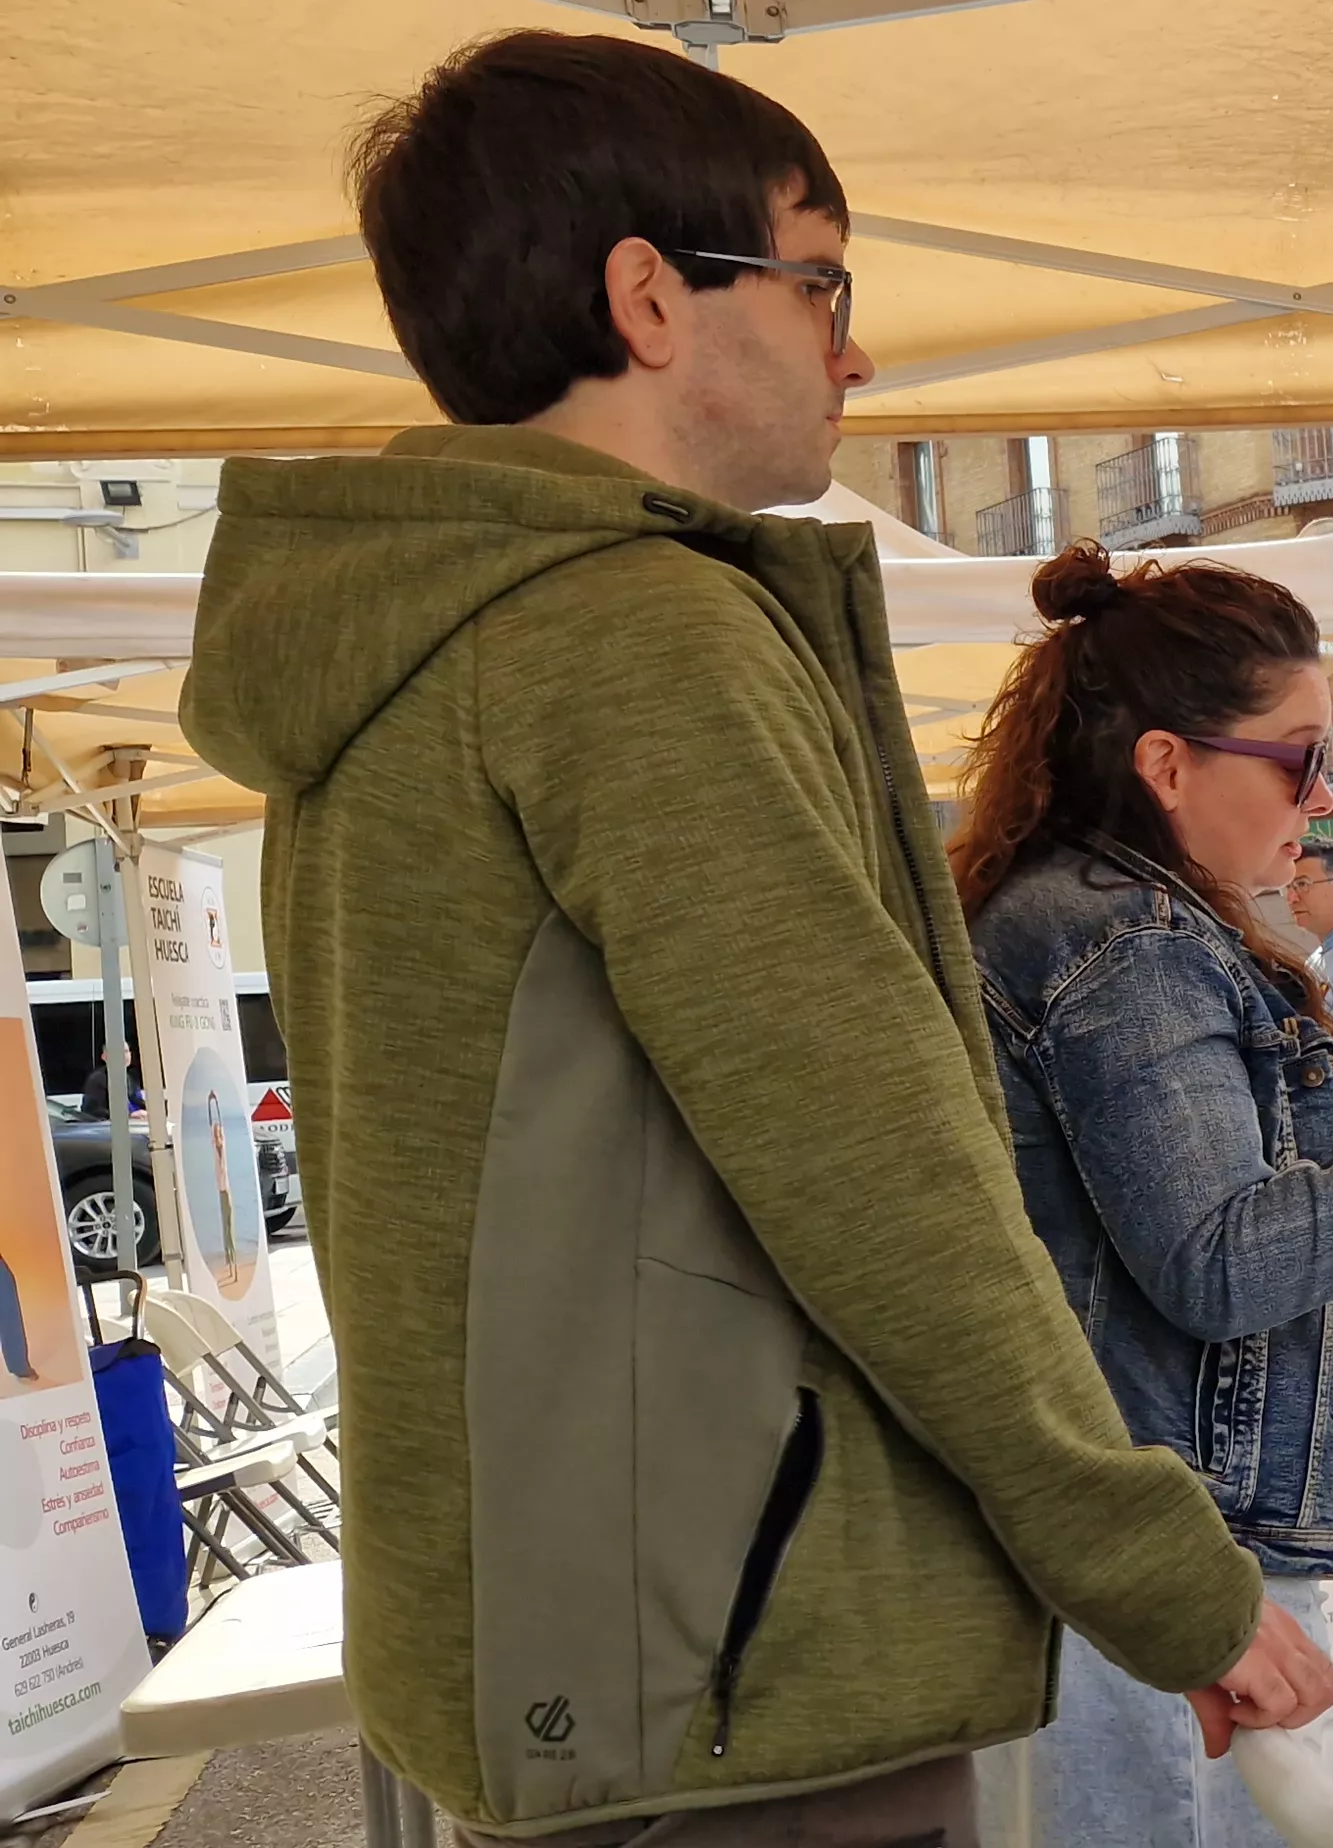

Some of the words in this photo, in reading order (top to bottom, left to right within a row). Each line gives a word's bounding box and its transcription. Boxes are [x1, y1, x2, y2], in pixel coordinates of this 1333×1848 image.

[148, 875, 185, 902] ESCUELA
[151, 906, 182, 932] TAICHÍ
[20, 1419, 57, 1439] Disciplina
[57, 1419, 63, 1434] y
[65, 1412, 91, 1430] respeto
[60, 1436, 96, 1455] Confianza
[60, 1460, 100, 1481] Autoestima
[41, 1494, 66, 1513] Estrés
[66, 1495, 72, 1510] y
[73, 1481, 104, 1503] ansiedad
[53, 1508, 109, 1536] Compañerismo
[1, 1627, 33, 1651] General
[33, 1617, 67, 1638] Lasheras,
[66, 1610, 75, 1624] 19
[19, 1648, 41, 1669] 22003
[41, 1639, 69, 1658] Huesca
[14, 1680, 28, 1697] 629
[8, 1682, 102, 1736] taichihuesca.com
